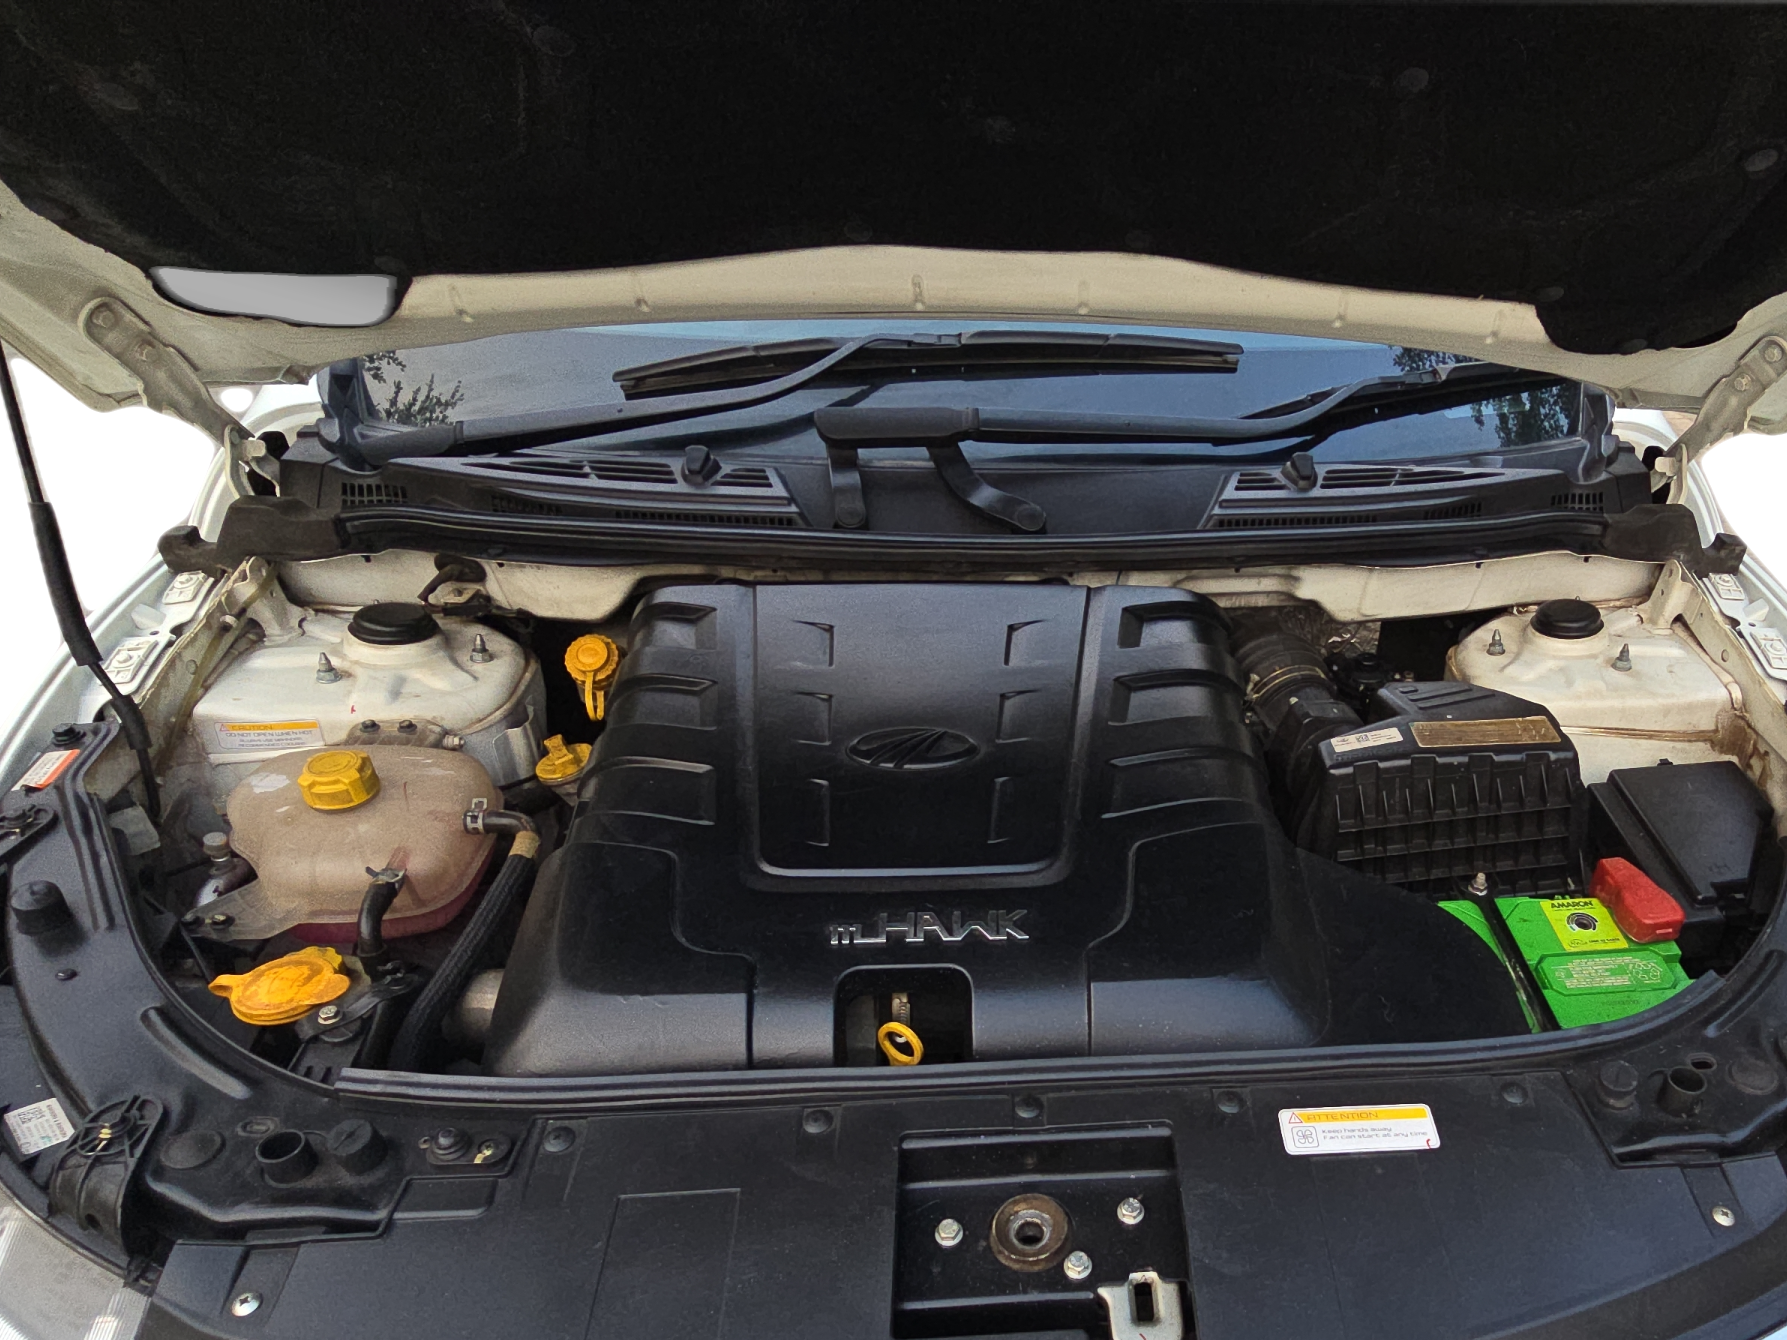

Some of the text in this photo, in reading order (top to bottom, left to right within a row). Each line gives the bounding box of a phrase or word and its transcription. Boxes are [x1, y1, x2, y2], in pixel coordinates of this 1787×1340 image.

[1550, 900, 1594, 909] AMARON
[829, 909, 1030, 946] mHAWK
[1306, 1112, 1379, 1121] ATTENTION
